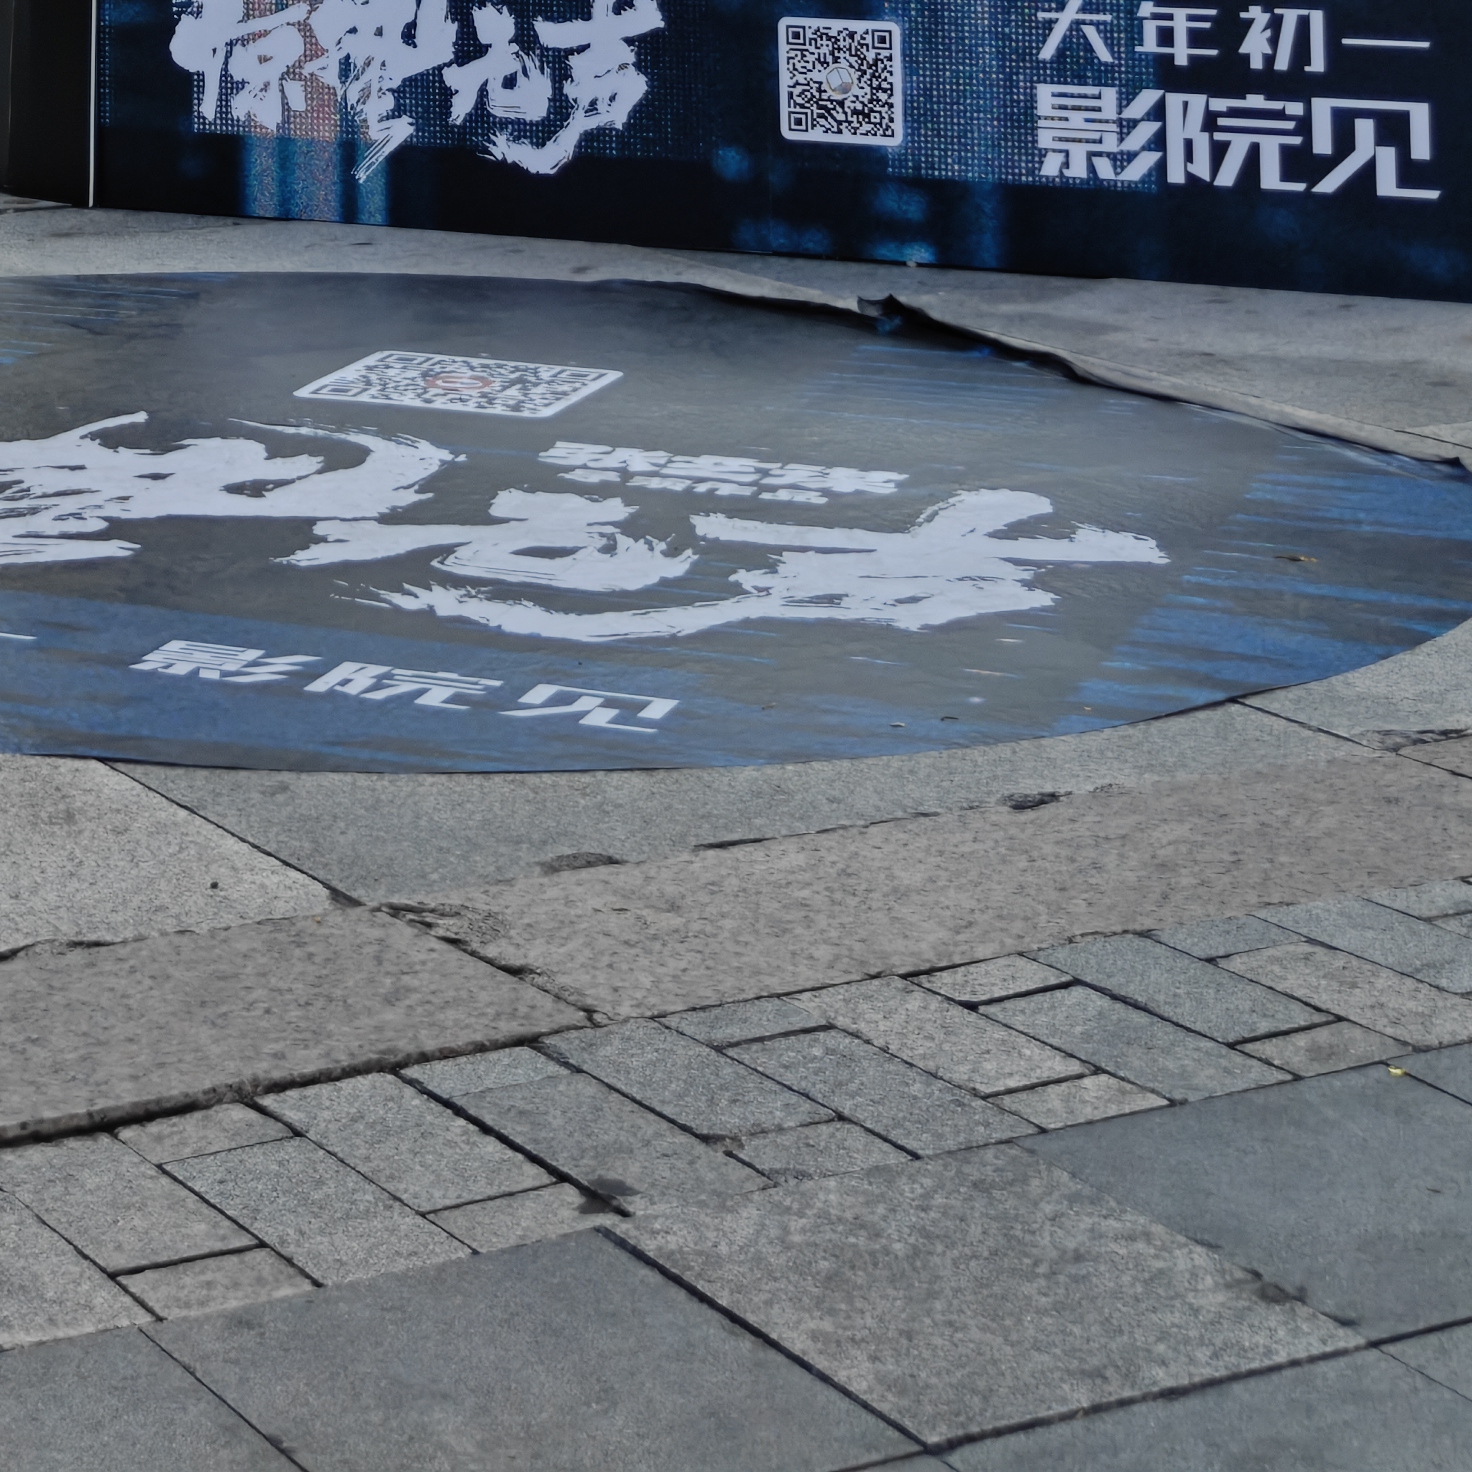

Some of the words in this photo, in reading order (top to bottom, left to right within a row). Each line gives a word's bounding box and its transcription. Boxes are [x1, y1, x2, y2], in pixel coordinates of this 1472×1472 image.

[1036, 84, 1442, 201] 影院见
[130, 639, 680, 733] 影院见
